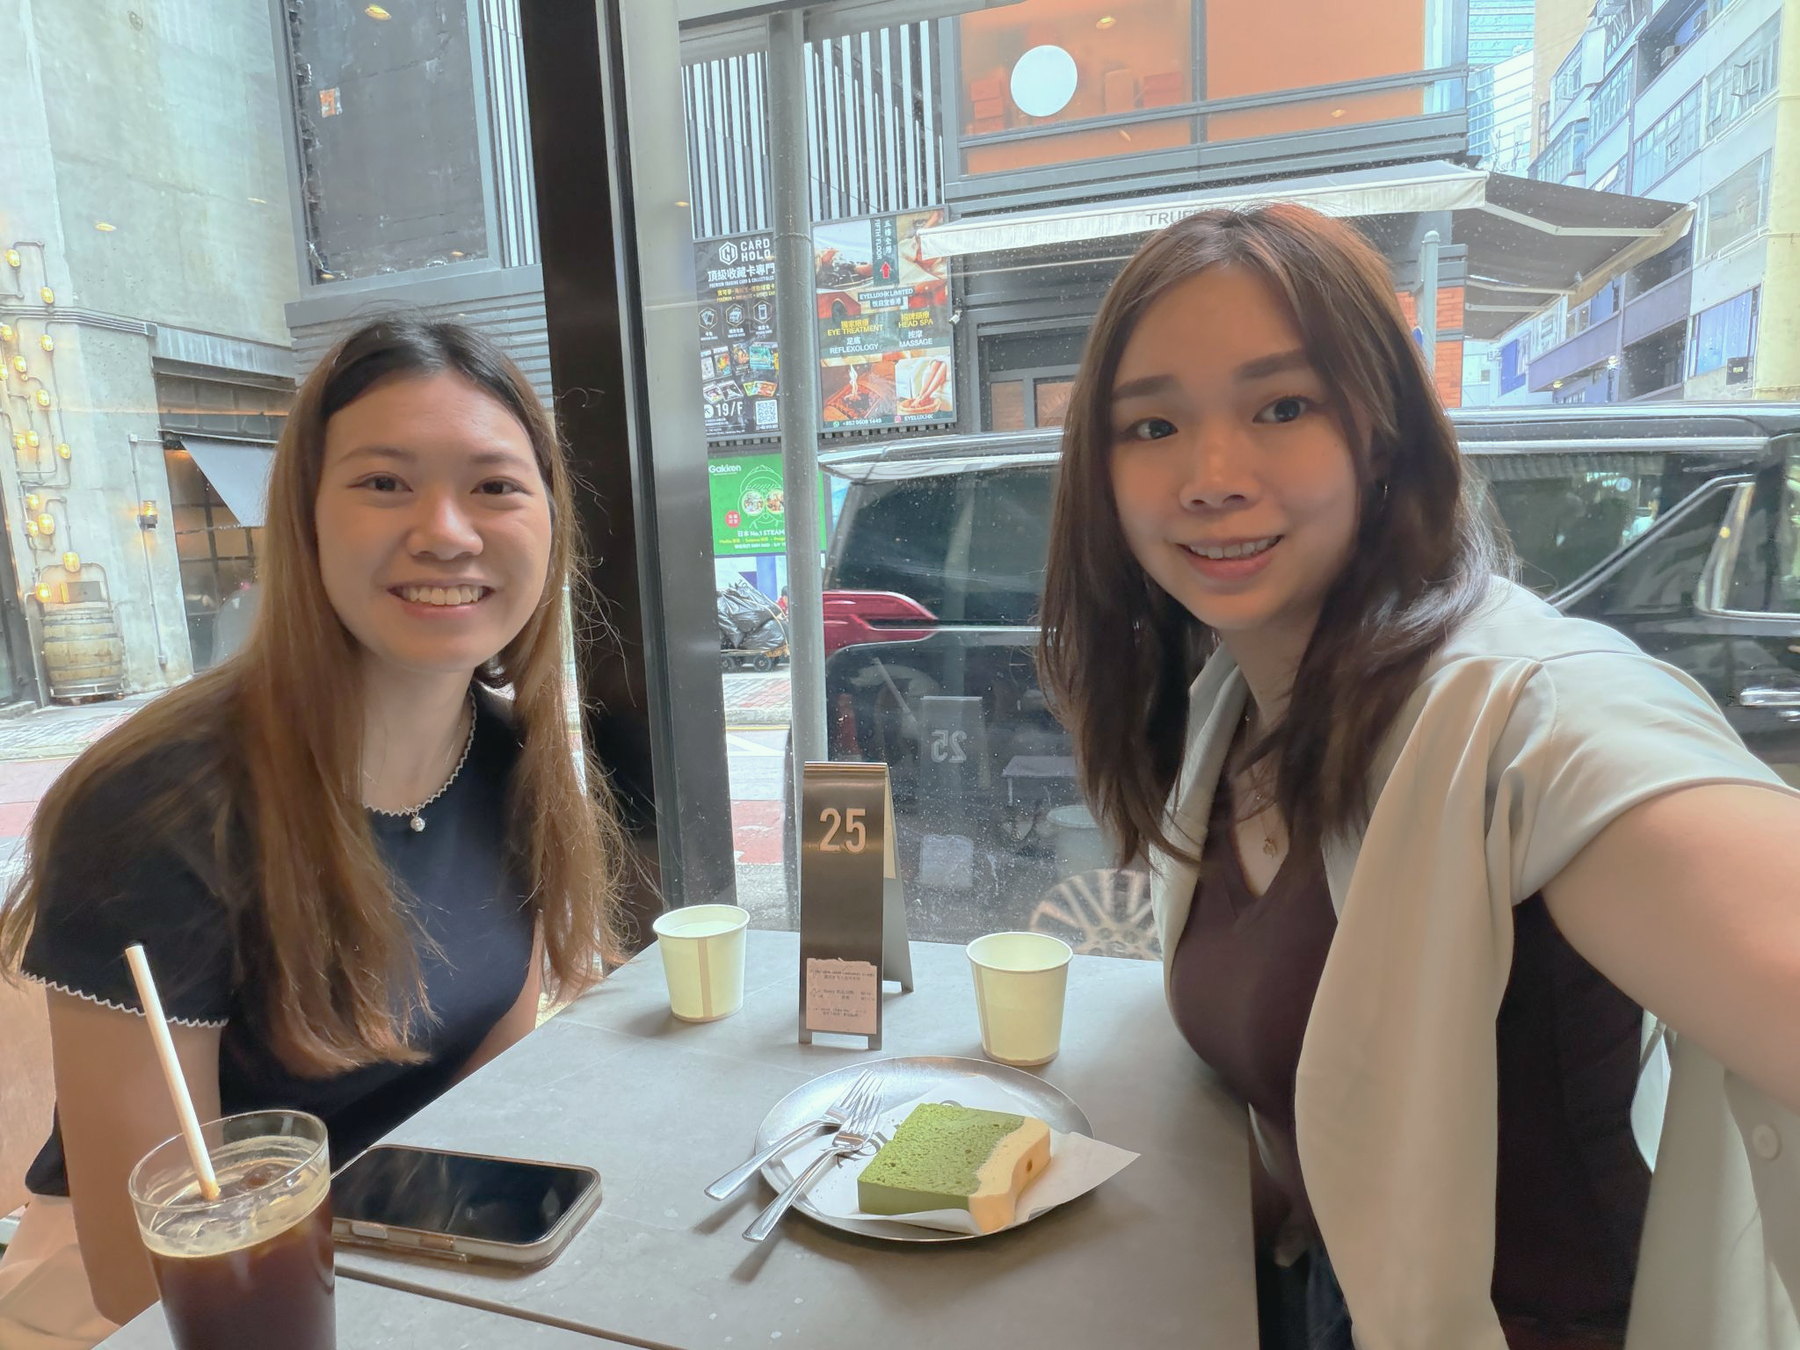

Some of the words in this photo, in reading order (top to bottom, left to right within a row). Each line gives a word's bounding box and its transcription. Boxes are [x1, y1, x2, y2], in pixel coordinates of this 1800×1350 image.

[740, 238, 770, 252] CARD
[741, 249, 771, 262] HOLO
[898, 320, 918, 329] HEAD
[919, 318, 934, 326] SPA
[827, 328, 841, 336] EYE
[843, 324, 884, 335] TREATMENT
[829, 343, 879, 354] REFLEXOLOGY
[899, 338, 933, 348] MASSAGE
[716, 401, 744, 417] 19/F
[708, 464, 742, 474] Gakken
[819, 807, 866, 854] 25
